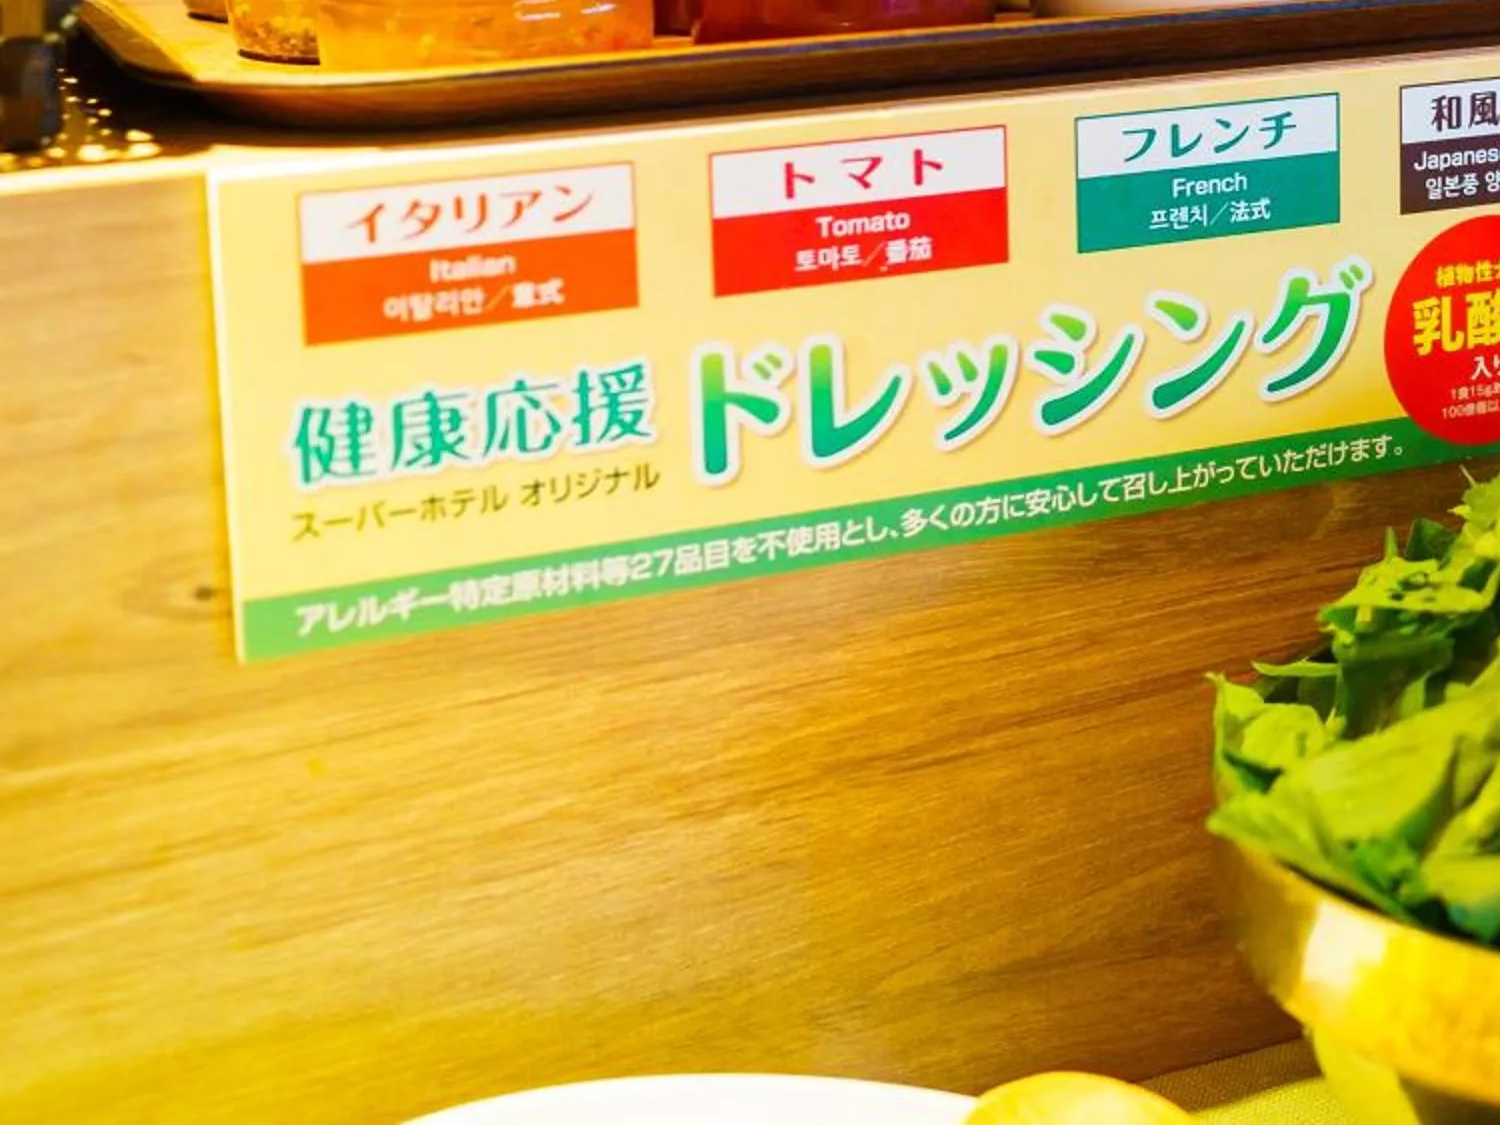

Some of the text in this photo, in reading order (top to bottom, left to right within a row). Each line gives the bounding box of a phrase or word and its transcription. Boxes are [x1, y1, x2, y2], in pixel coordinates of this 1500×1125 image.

[1121, 110, 1297, 163] フレンチ
[783, 147, 944, 200] トマト
[1171, 171, 1249, 199] French
[1424, 172, 1480, 201] 일본풍
[346, 184, 594, 244] イタリアン
[815, 210, 911, 239] Tomato
[429, 254, 518, 284] Italian
[293, 262, 1367, 484] 健康応援 ドレッシング
[290, 462, 661, 543] スーパーホテル オリジナル
